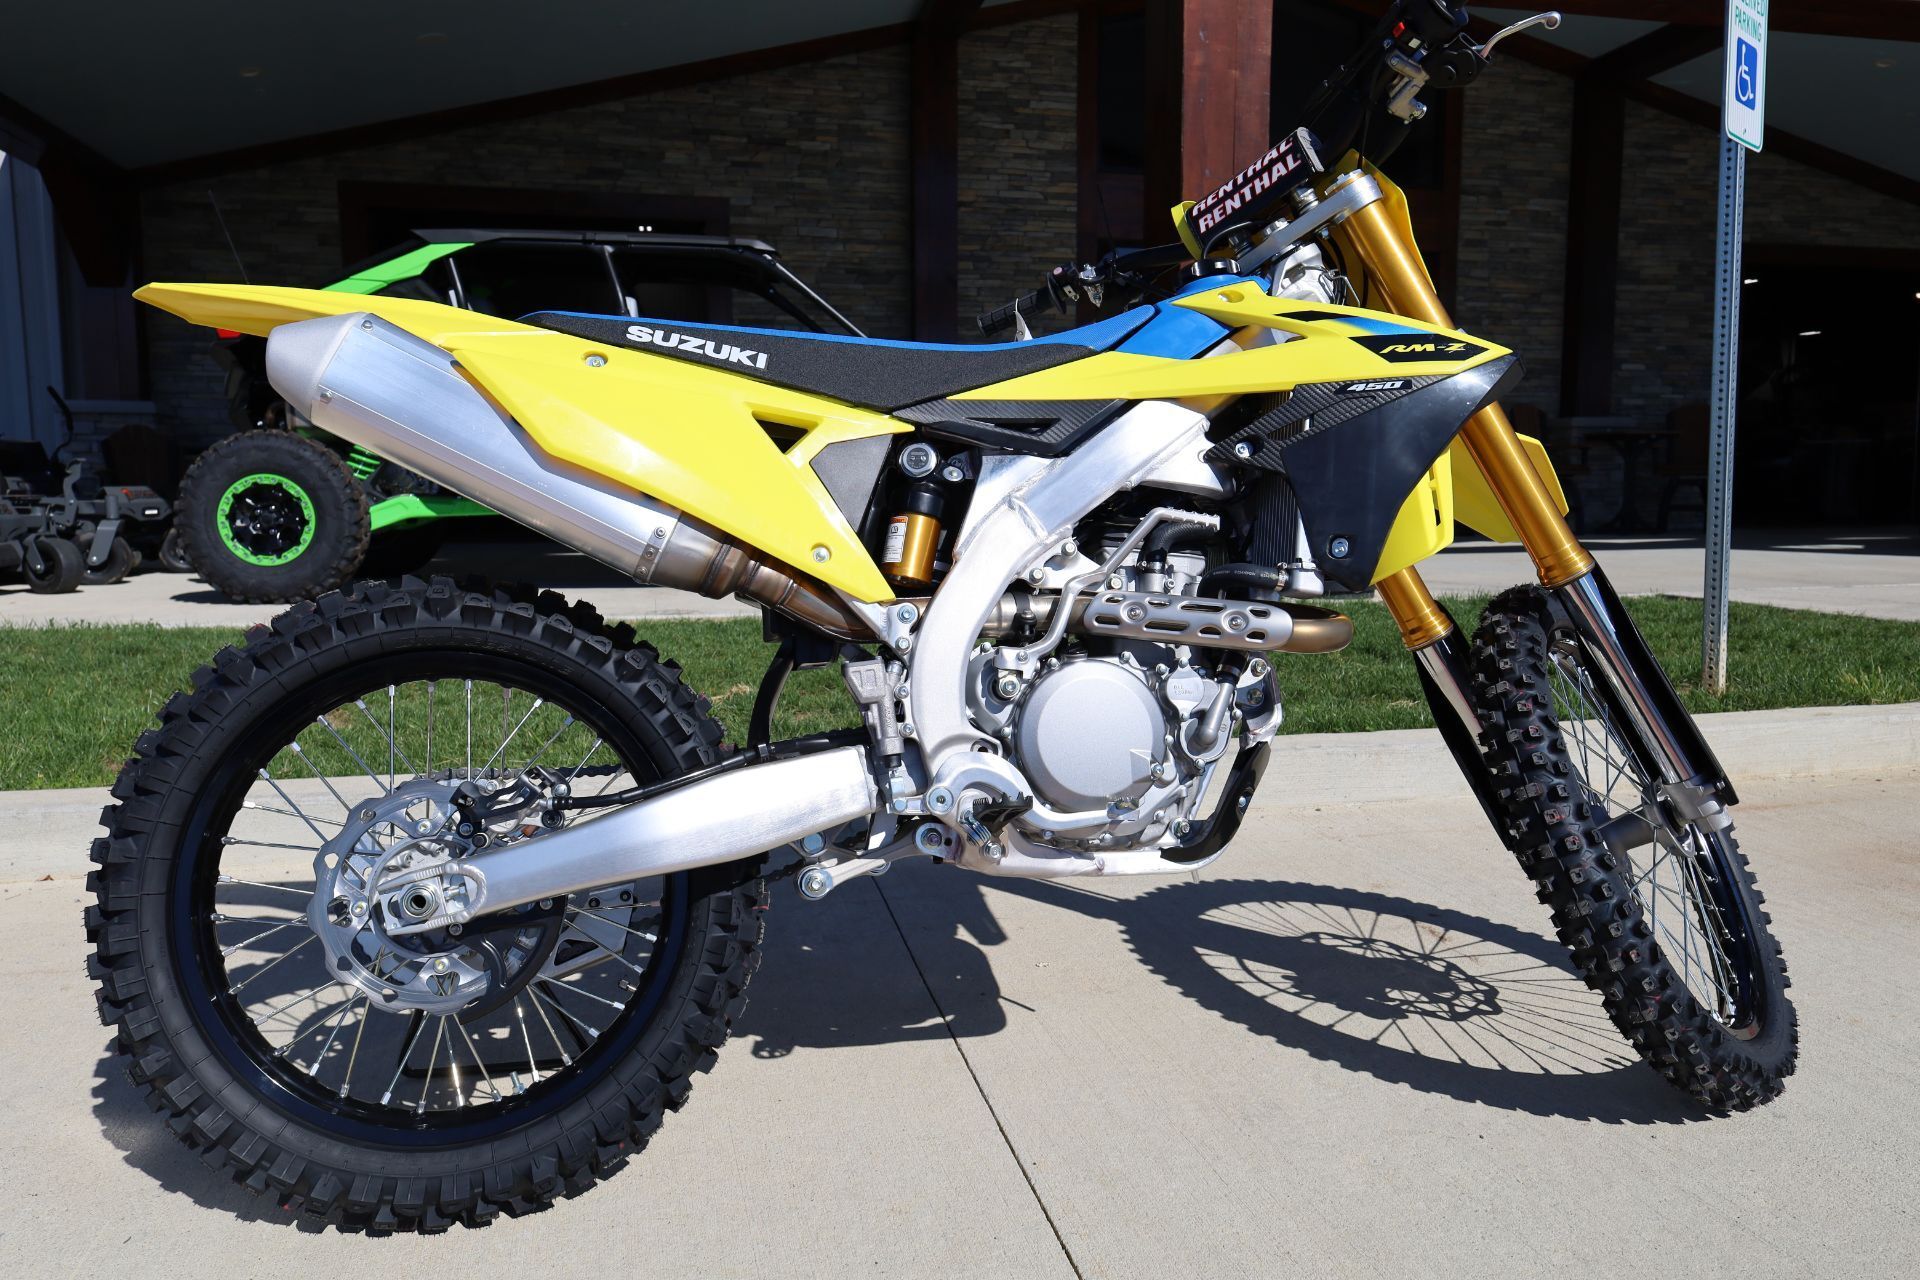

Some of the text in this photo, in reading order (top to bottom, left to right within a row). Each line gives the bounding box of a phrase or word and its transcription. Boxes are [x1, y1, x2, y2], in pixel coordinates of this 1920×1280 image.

[1735, 5, 1761, 42] PARKING
[1192, 139, 1293, 217] RENTHAL
[1198, 154, 1302, 234] RENTHAL
[626, 325, 768, 370] SUZUKI
[1379, 342, 1467, 354] RM-Z
[1346, 380, 1405, 392] 450
